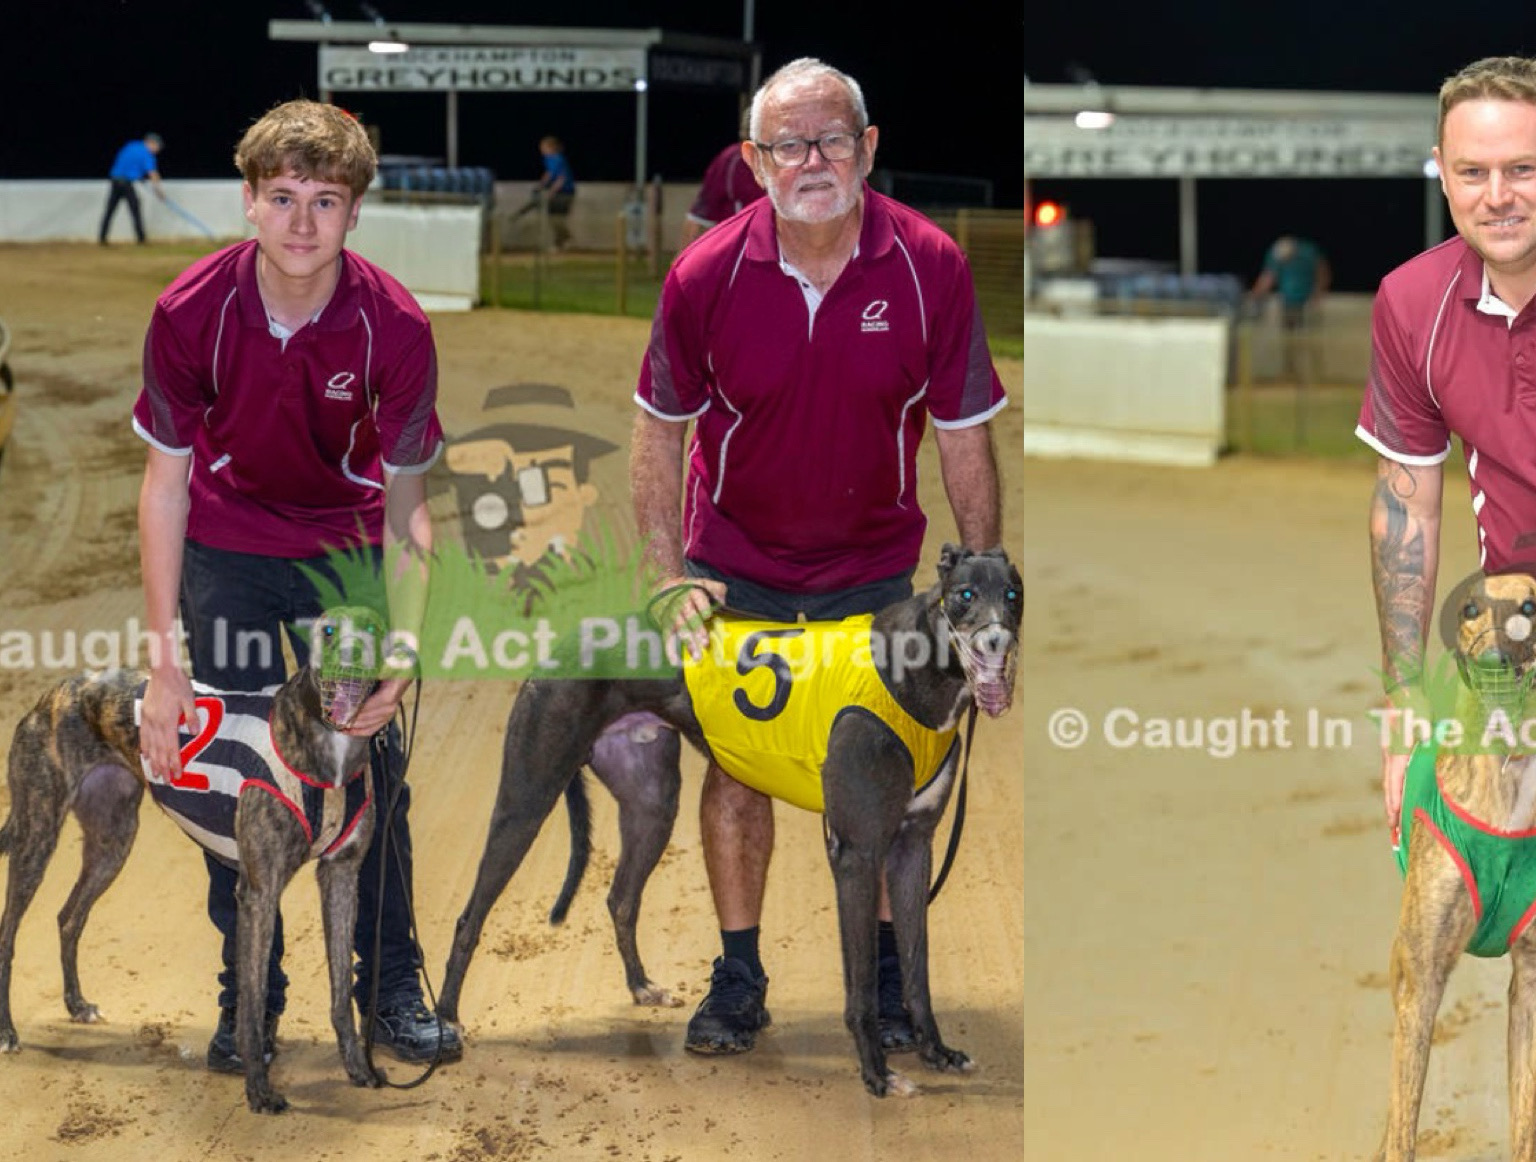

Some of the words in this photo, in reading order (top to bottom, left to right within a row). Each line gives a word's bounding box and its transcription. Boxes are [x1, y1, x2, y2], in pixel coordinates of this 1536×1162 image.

[326, 67, 638, 88] GREYHOUNDS
[733, 628, 805, 721] 5
[170, 697, 225, 792] 2
